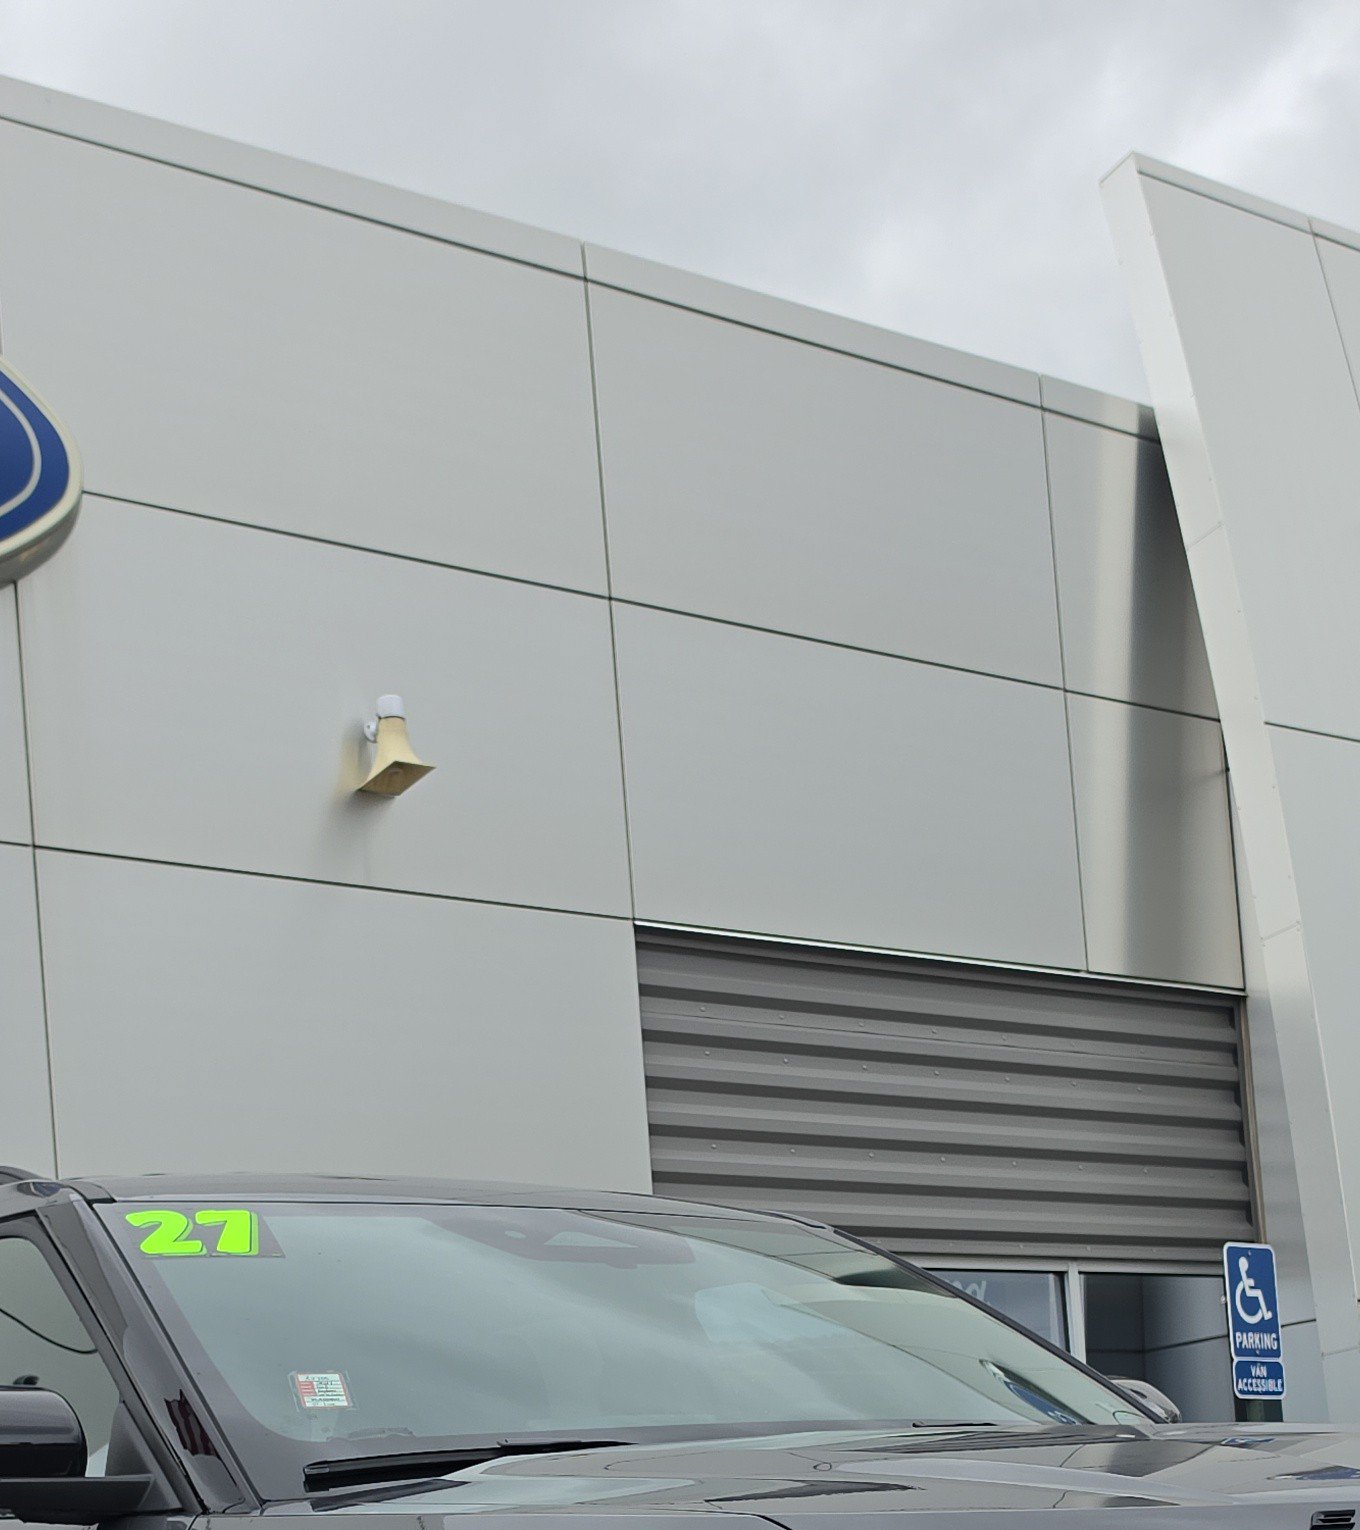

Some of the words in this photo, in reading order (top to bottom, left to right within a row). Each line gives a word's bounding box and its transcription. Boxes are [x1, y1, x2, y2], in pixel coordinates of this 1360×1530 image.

[125, 1209, 260, 1256] 27
[1236, 1332, 1277, 1349] PARKING
[1251, 1364, 1267, 1377] VAN
[1237, 1379, 1282, 1391] ACCESSIBLE
